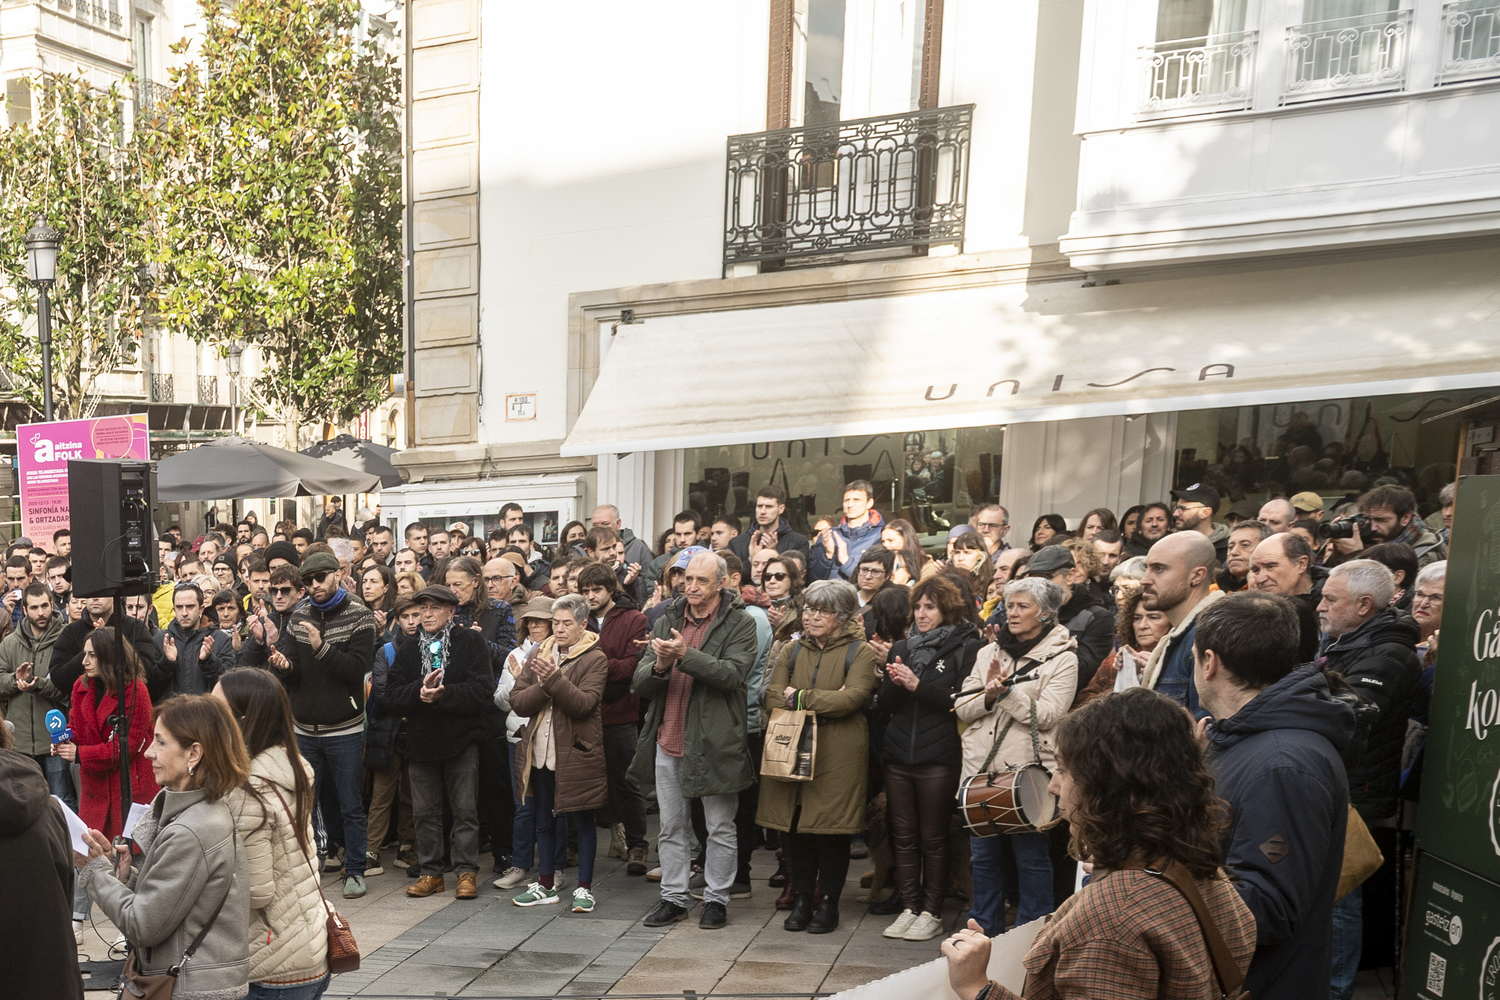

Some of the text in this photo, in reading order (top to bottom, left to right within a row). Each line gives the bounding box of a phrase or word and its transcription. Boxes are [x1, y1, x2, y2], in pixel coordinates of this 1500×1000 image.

[55, 441, 82, 450] aitzina
[55, 450, 83, 461] FOLK
[28, 504, 70, 515] SINFONÍA NA
[35, 514, 70, 524] ORTZADAR
[1464, 679, 1500, 741] ko
[58, 732, 69, 741] etb
[1424, 909, 1451, 933] gasteiz
